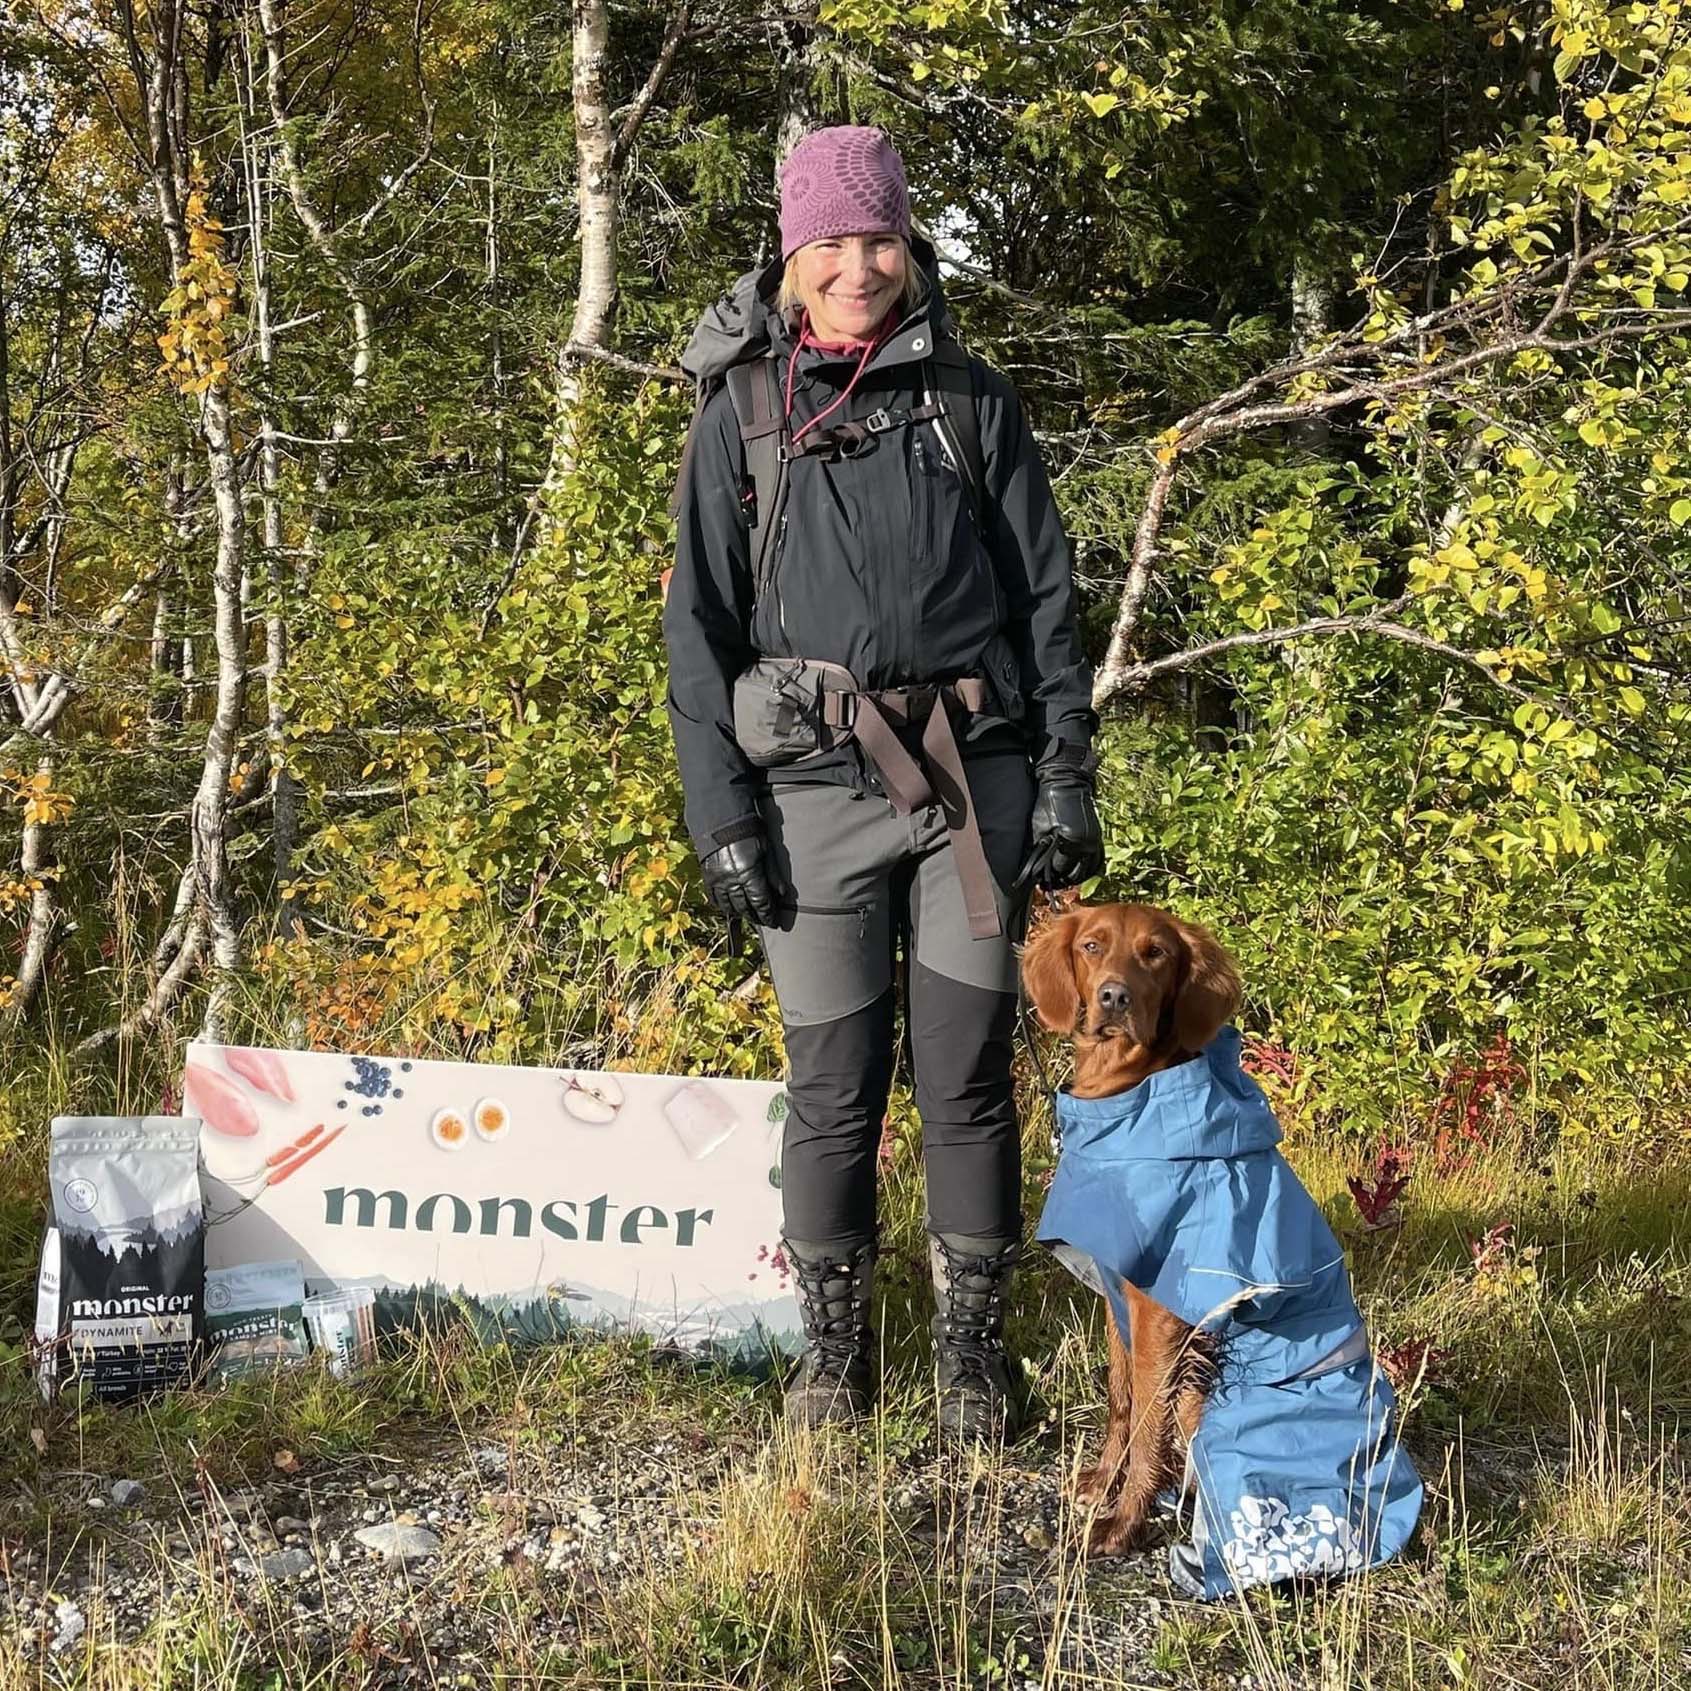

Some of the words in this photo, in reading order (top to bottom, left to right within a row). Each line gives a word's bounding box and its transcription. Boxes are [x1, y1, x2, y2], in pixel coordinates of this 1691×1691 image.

[322, 1186, 714, 1247] monster
[72, 1293, 194, 1316] monster
[80, 1326, 143, 1339] DYNAMITE
